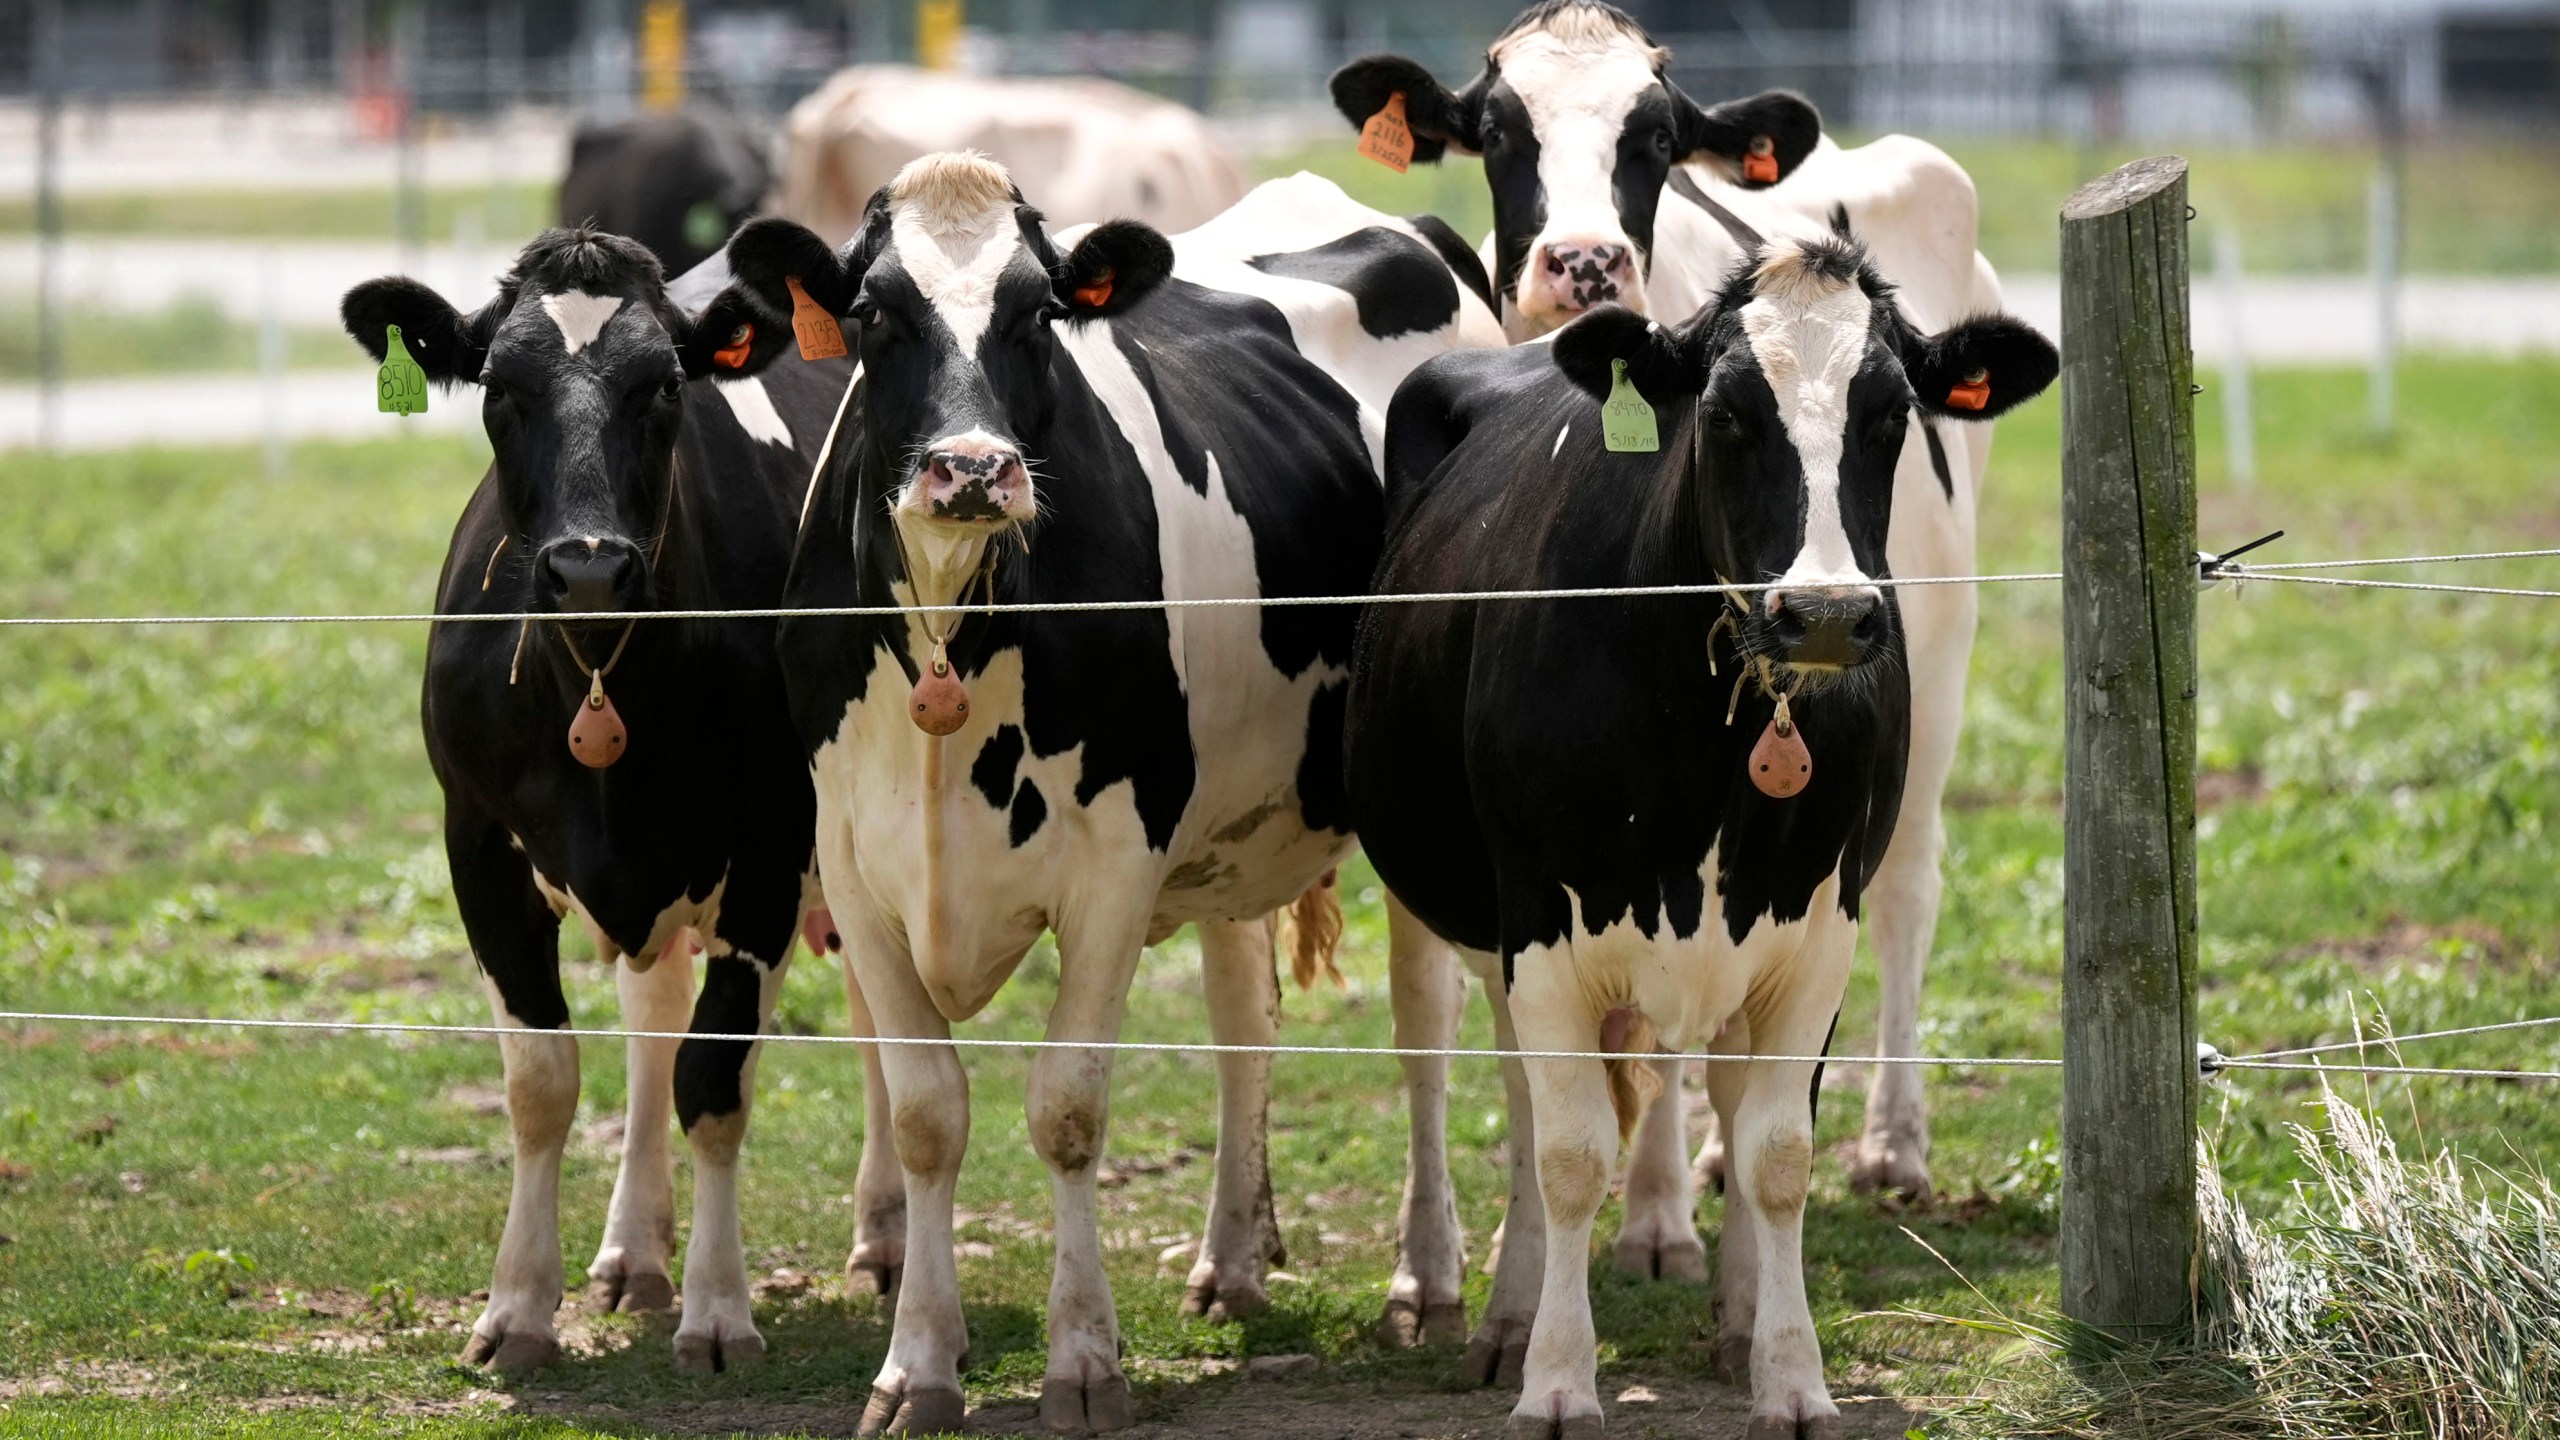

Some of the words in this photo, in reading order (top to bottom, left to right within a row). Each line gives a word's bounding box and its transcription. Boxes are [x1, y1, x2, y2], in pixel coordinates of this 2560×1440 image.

[1371, 121, 1405, 147] 2116
[797, 319, 841, 349] 2135
[380, 362, 422, 400] 8510
[1610, 400, 1648, 416] 8470
